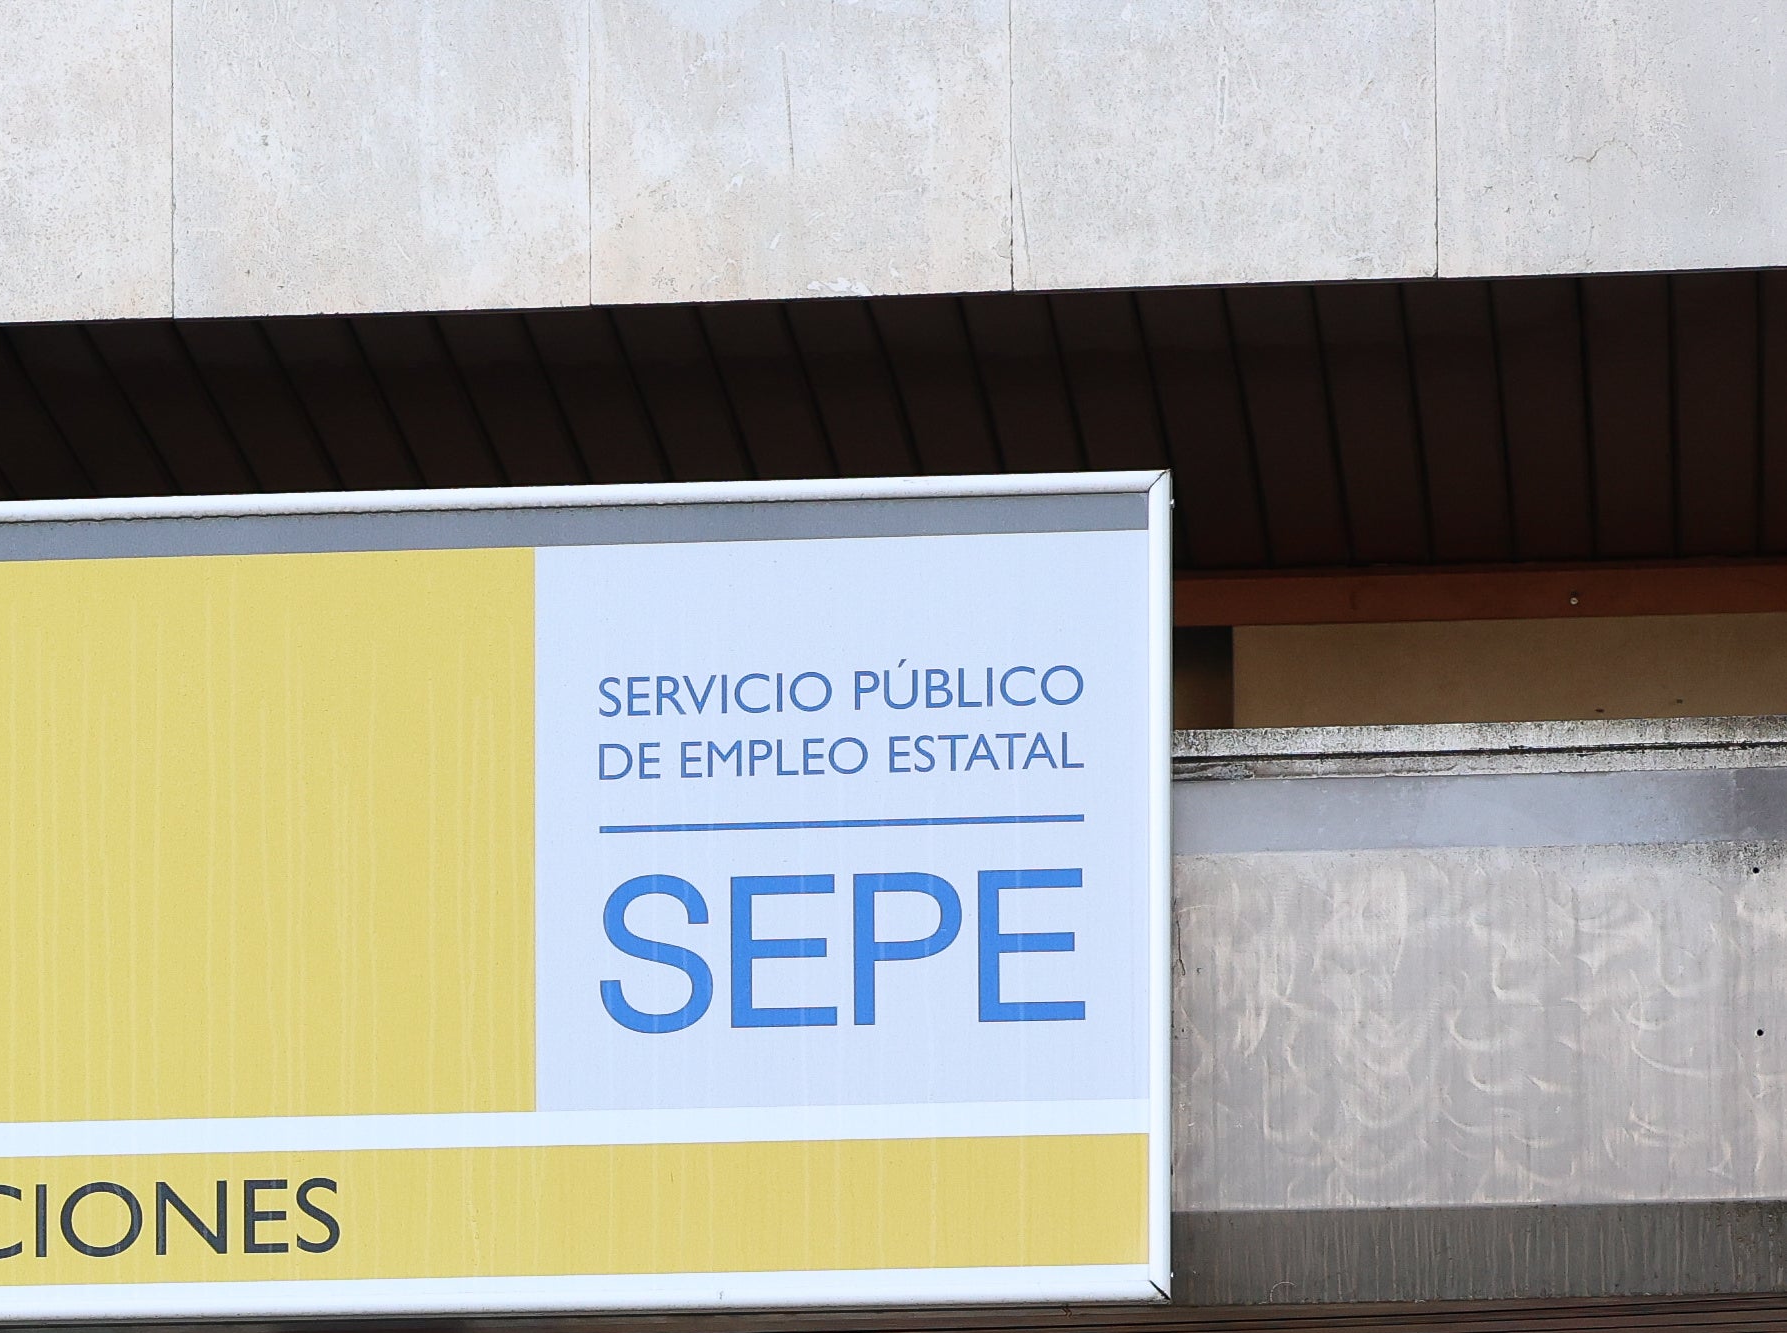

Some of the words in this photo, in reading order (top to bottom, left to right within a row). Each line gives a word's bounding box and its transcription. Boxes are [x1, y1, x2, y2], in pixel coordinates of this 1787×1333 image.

[599, 671, 832, 717] SERVICIO
[854, 659, 1084, 710] PÚBLICO
[599, 742, 660, 780] DE
[680, 736, 868, 778] EMPLEO
[889, 731, 1084, 772] ESTATAL
[600, 868, 1085, 1034] SEPE
